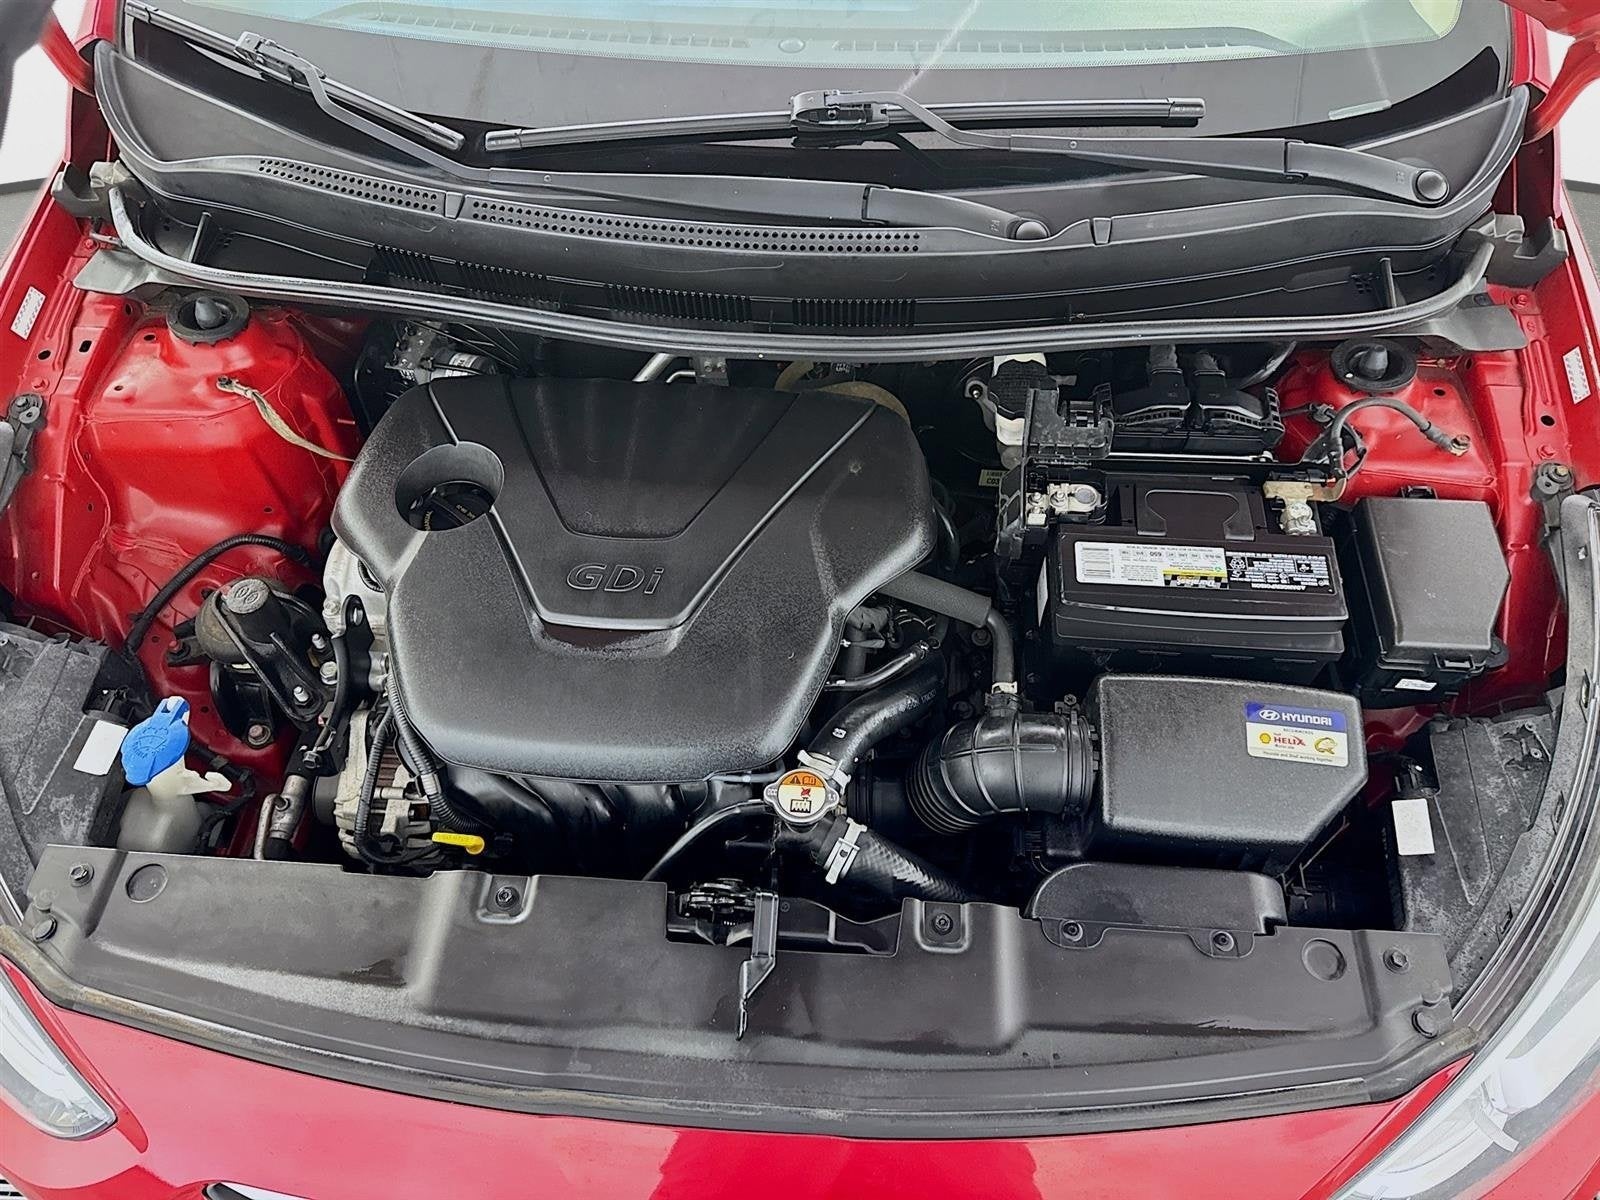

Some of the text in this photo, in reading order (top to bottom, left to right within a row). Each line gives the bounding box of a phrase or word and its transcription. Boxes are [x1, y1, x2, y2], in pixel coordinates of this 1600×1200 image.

[566, 562, 665, 595] GDi
[1282, 712, 1332, 726] HYUNDAI
[1274, 735, 1306, 746] HELIX
